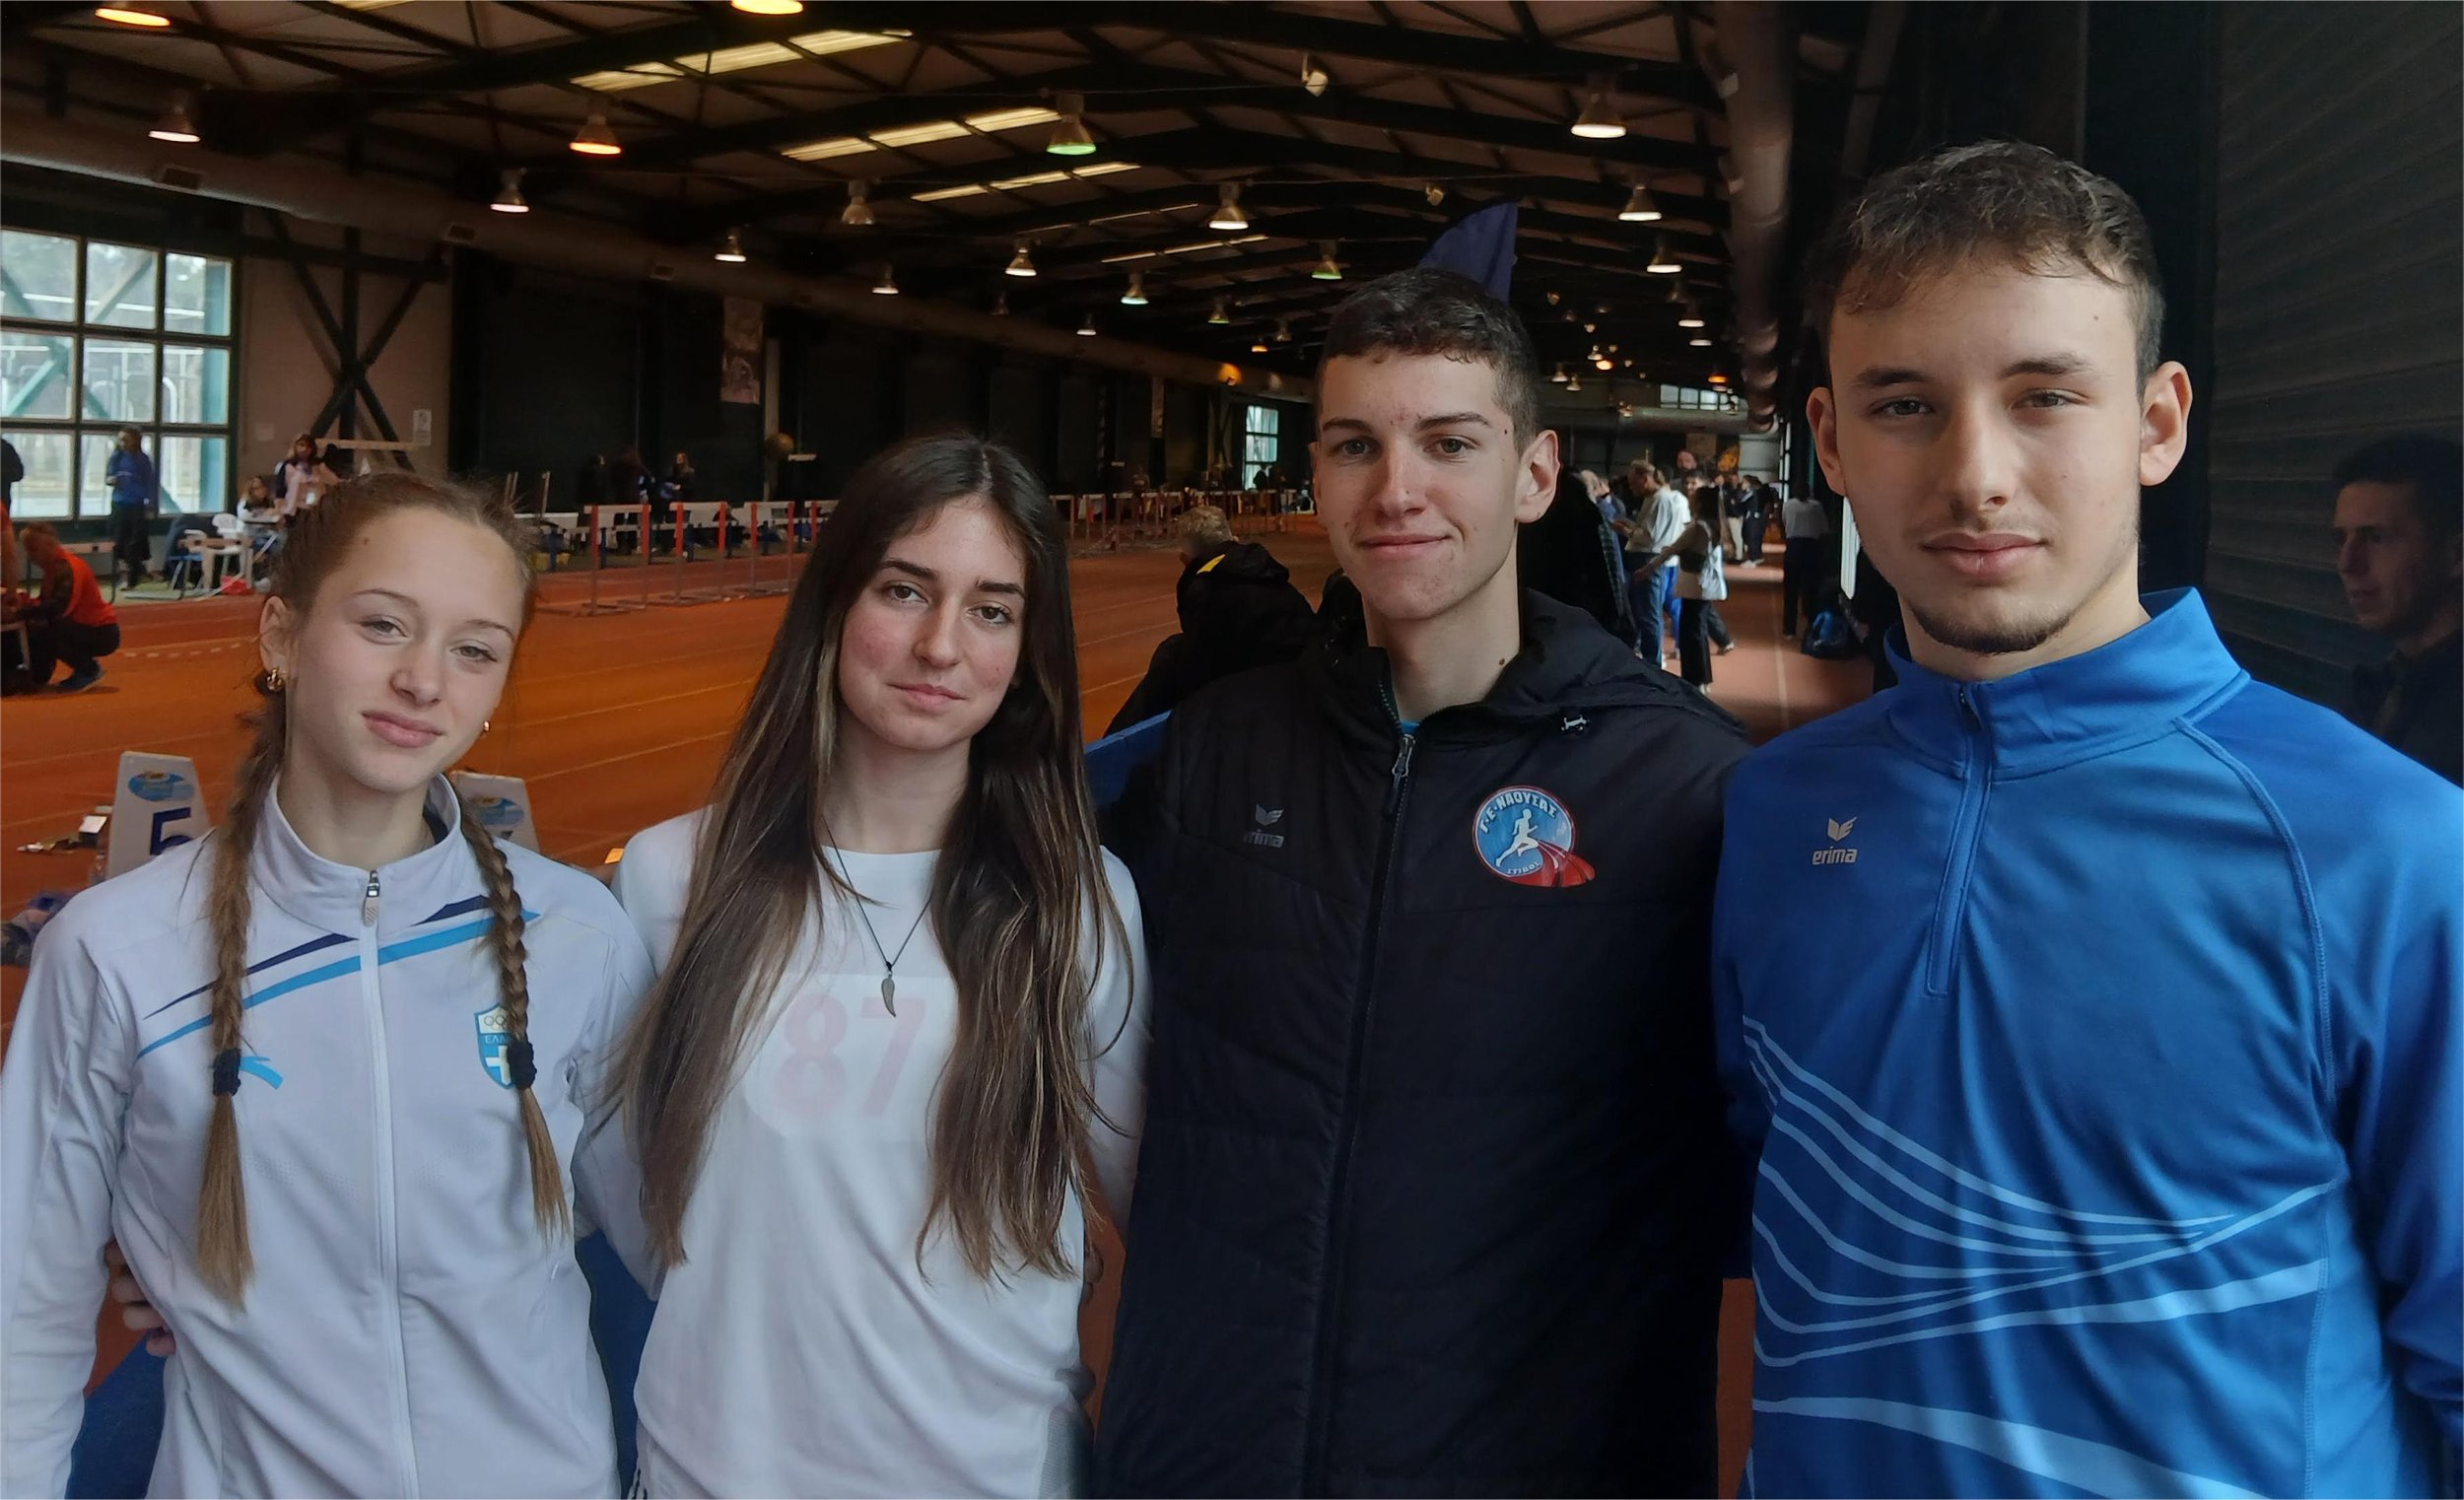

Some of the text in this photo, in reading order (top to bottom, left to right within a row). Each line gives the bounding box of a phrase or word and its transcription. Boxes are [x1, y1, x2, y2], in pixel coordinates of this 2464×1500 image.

[150, 806, 194, 856] 5
[1813, 846, 1858, 865] erima
[484, 1034, 510, 1045] ΕΛΛ
[774, 993, 926, 1118] 87
